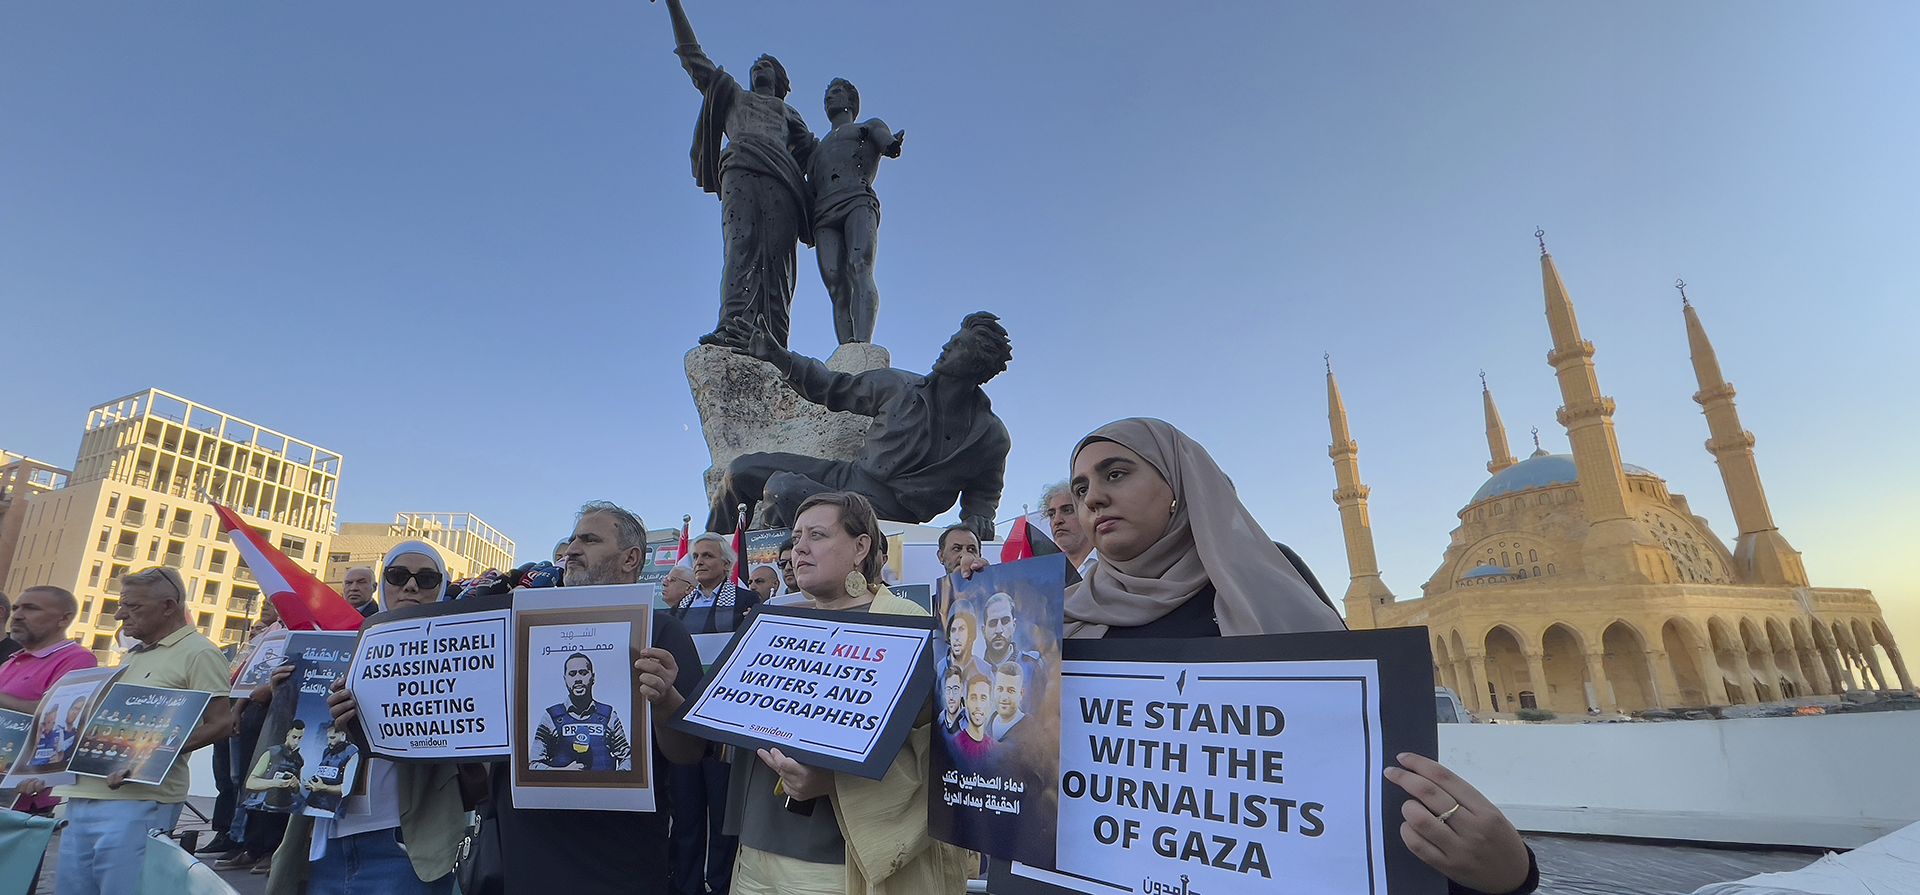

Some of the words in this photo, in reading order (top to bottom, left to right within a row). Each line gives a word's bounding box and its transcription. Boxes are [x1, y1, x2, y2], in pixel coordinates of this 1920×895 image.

[560, 627, 596, 640] الشهيد
[302, 647, 339, 664] الحقيقة
[365, 642, 394, 661] END
[398, 639, 429, 656] THE
[433, 633, 496, 653] ISRAELI
[541, 642, 578, 656] منصور
[579, 642, 614, 651] محمد
[768, 634, 827, 656] ISRAEL
[831, 642, 887, 663] KILLS
[362, 652, 495, 680] ASSASSINATION
[747, 652, 879, 687] JOURNALISTS,
[397, 678, 456, 697] POLICY
[739, 670, 819, 699] WRITERS,
[824, 685, 873, 706] AND
[381, 697, 475, 717] TARGETING
[712, 686, 880, 732] PHOTOGRAPHERS
[1080, 696, 1133, 727] WE
[1145, 700, 1286, 737] STAND
[379, 716, 485, 740] JOURNALISTS
[564, 725, 602, 734] PRSS
[749, 722, 793, 739] samidoun
[410, 736, 448, 749] samidoun
[1088, 734, 1189, 773] WITH
[1202, 745, 1284, 783] THE
[959, 772, 1002, 791] الصحافيين
[1003, 778, 1024, 793] دماء
[943, 788, 962, 806] الحرية
[963, 792, 983, 812] بمداد
[985, 794, 1020, 815] الحقيقة
[1062, 770, 1325, 838] OURNALISTS
[1094, 814, 1140, 849] OF
[1152, 825, 1272, 879] GAZA
